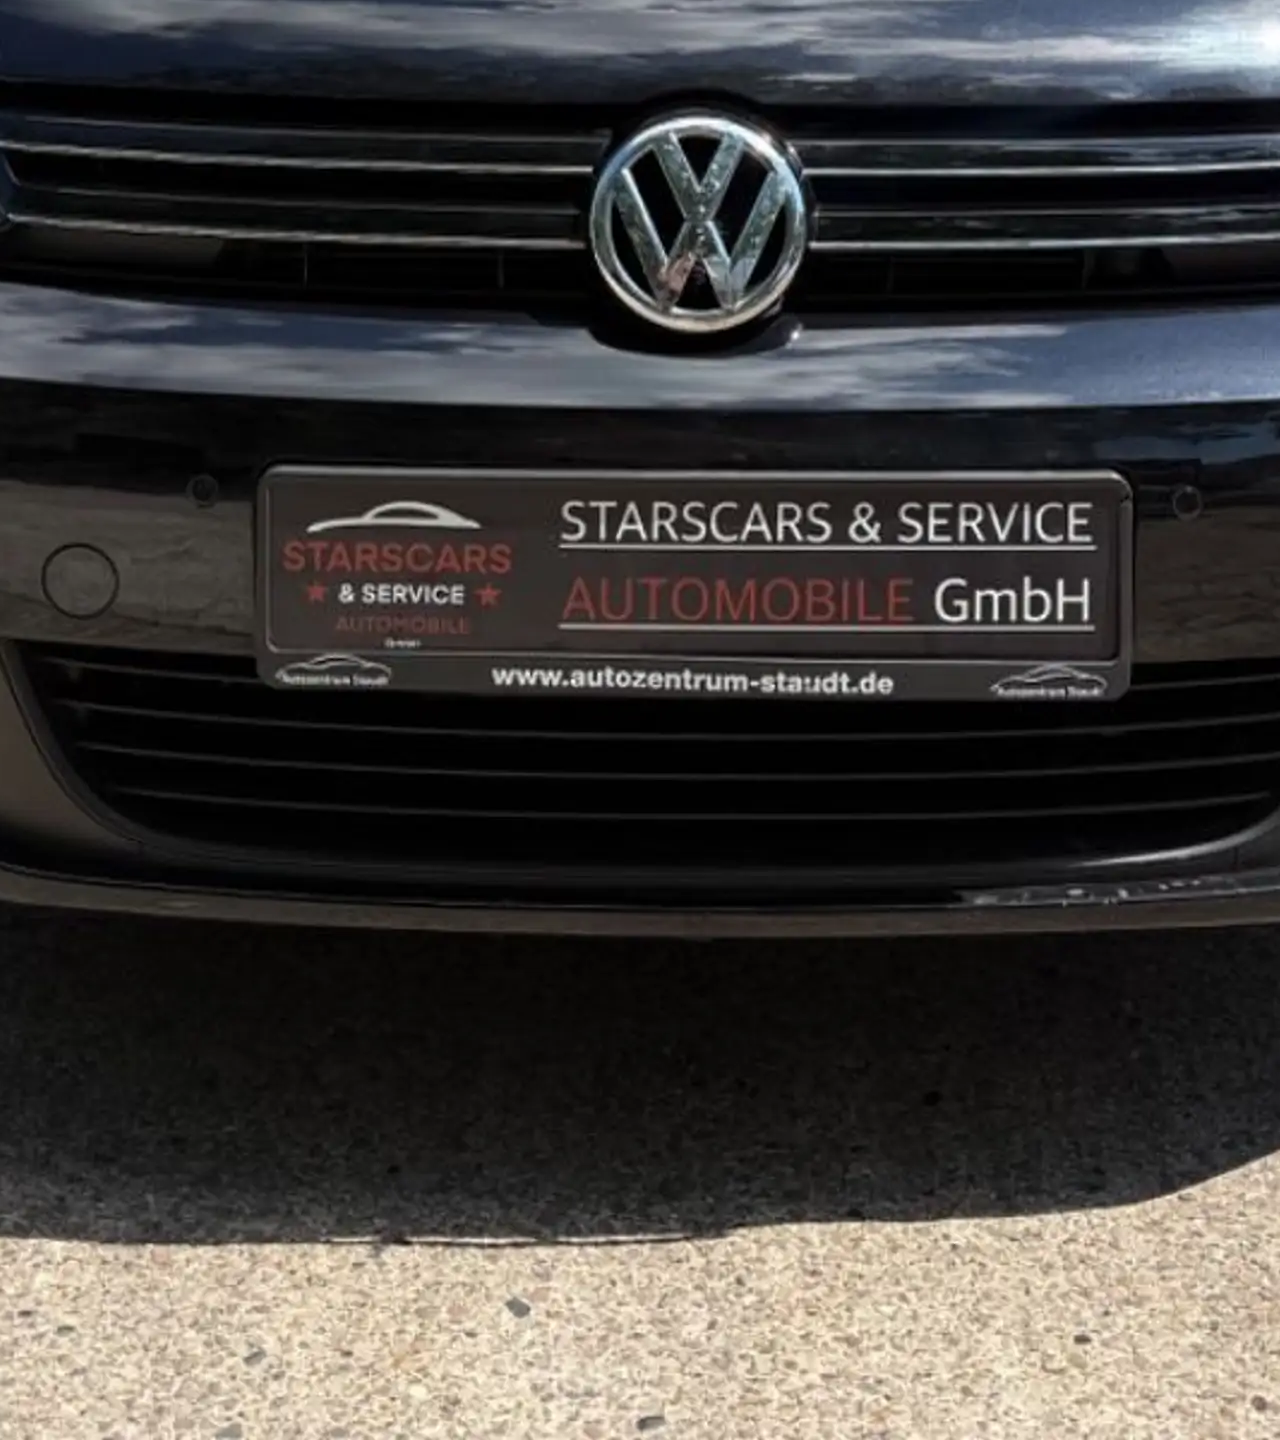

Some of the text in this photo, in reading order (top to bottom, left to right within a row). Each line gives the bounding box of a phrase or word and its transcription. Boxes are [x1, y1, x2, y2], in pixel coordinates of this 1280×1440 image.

[560, 500, 1094, 544] STARSCARS & SERVICE
[282, 541, 513, 574] STARSCARS
[338, 582, 466, 606] & SERVICE
[561, 575, 1090, 623] AUTOMOBILE GmbH
[335, 615, 470, 635] AUTOMOBILE
[491, 666, 895, 695] www.autozentrum-staudt.de
